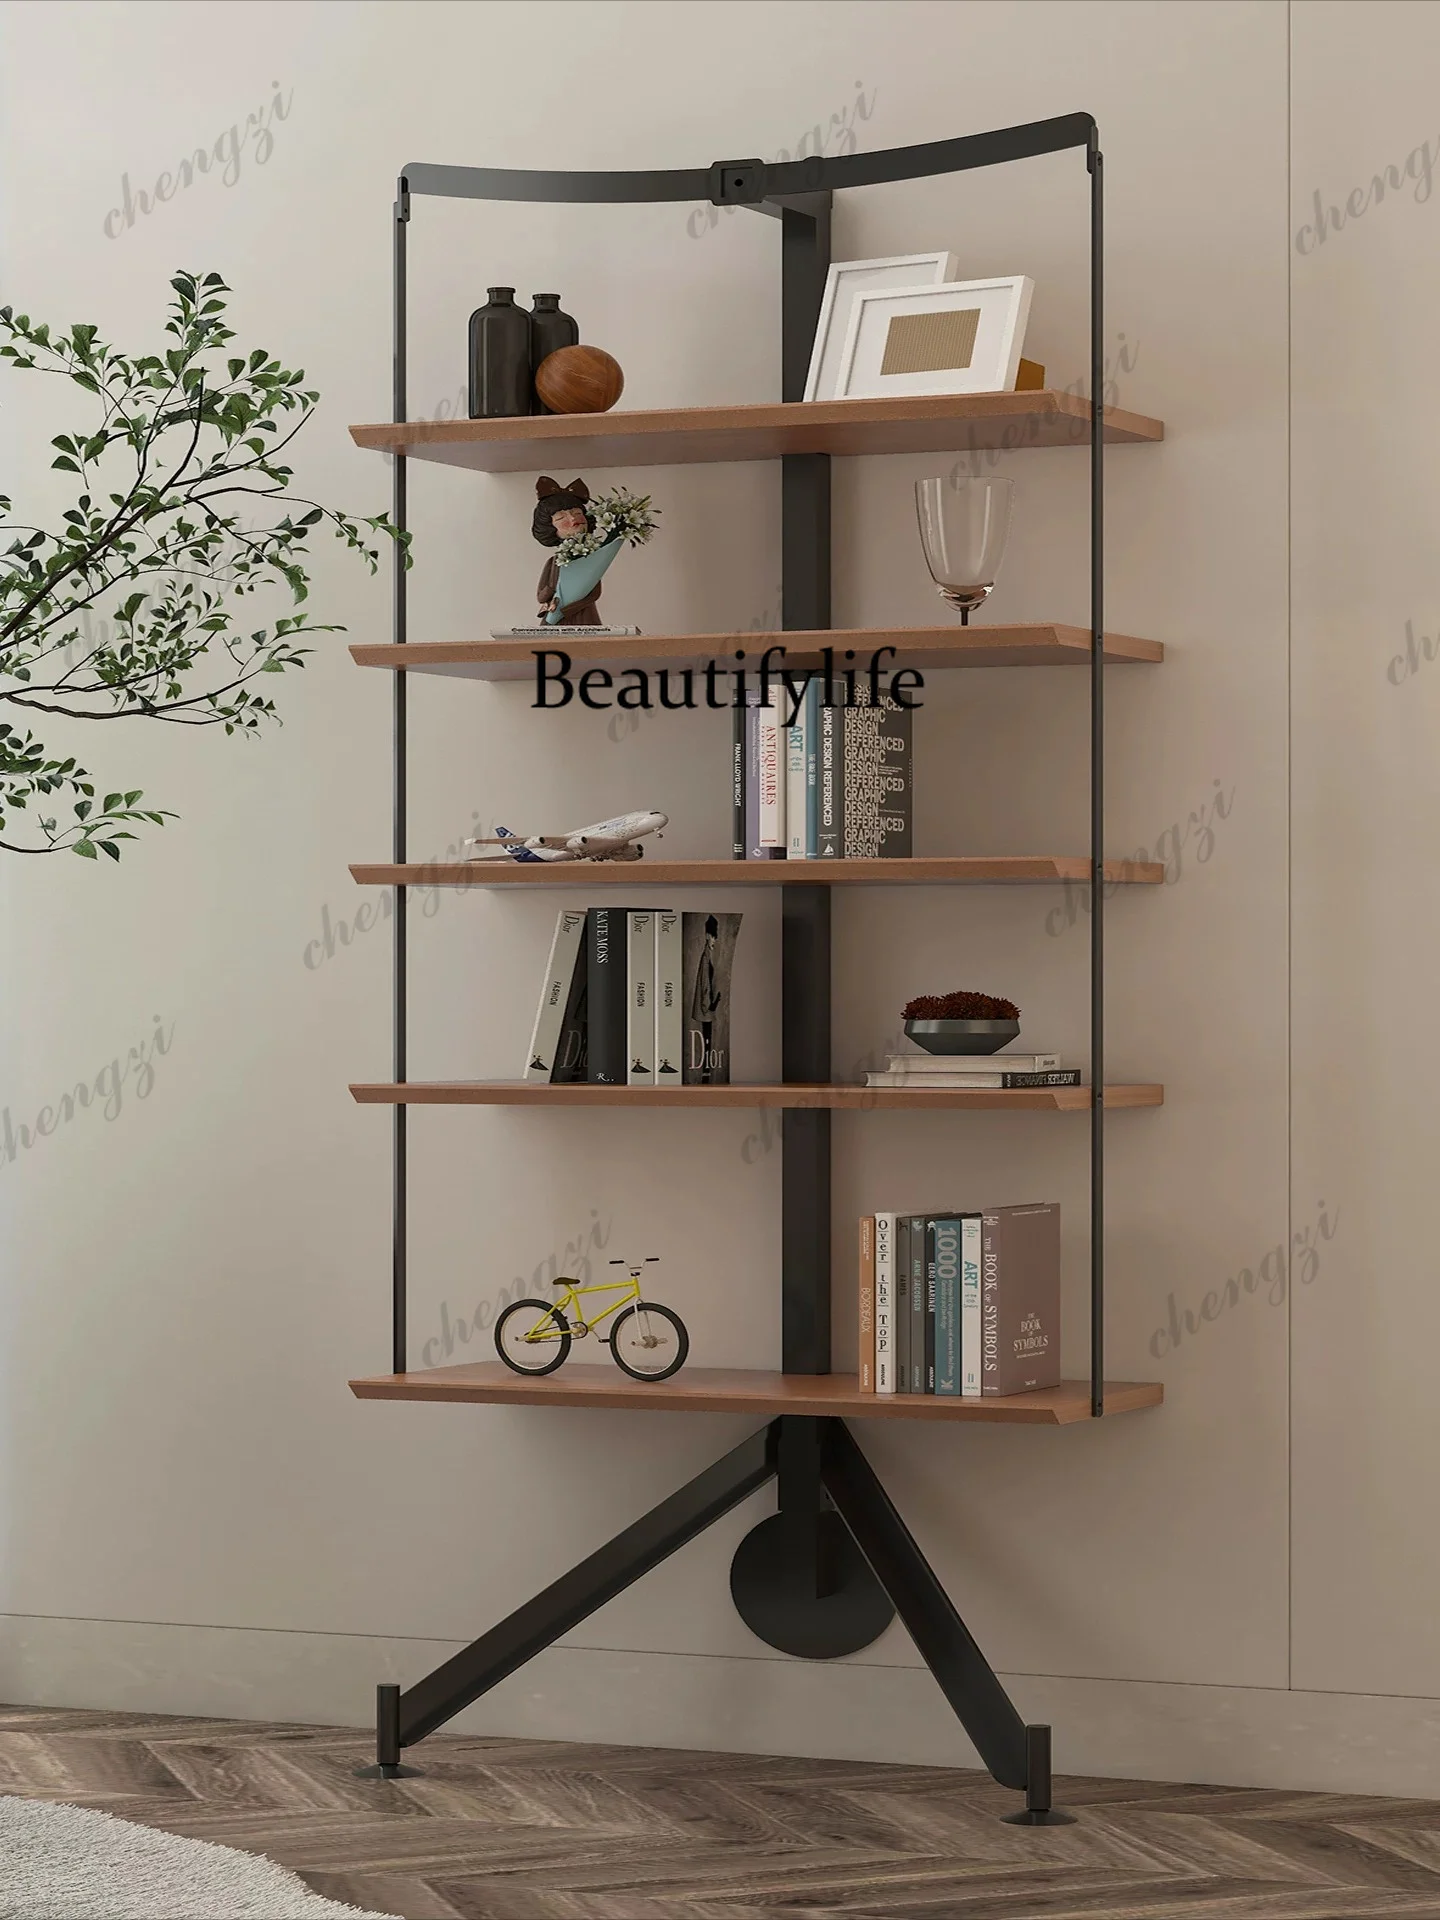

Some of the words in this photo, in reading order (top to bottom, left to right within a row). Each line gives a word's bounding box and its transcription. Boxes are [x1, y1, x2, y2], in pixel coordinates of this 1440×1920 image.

[844, 706, 886, 723] GRAPHIC
[844, 719, 879, 736] DESIGN
[844, 733, 905, 752] REFERENCED
[734, 743, 742, 762] FRANK
[823, 737, 832, 769] DESIGN
[844, 746, 886, 763] GRAPHIC
[734, 763, 742, 783] LLOYD
[765, 725, 776, 805] ANTIQUAIRES
[844, 760, 879, 776] DESIGN
[844, 773, 905, 792] REFERENCED
[734, 784, 742, 807] WRIGHT
[823, 770, 832, 826] REFERENCED
[844, 787, 886, 804] GRAPHIC
[844, 801, 879, 816] DESIGN
[844, 814, 905, 832] REFERENCED
[844, 828, 886, 844] GRAPHIC
[844, 841, 879, 857] DESIGN
[562, 915, 580, 934] Dior
[596, 910, 608, 937] KATE
[633, 915, 649, 933] Dior
[661, 915, 677, 933] Dior
[596, 938, 608, 964] MOSS
[549, 980, 562, 1006] FASHION
[636, 982, 646, 1007] FASHION
[664, 982, 673, 1007] FASHION
[688, 1029, 725, 1070] Dior
[878, 1219, 888, 1263] Over
[937, 1227, 958, 1279] 1000
[913, 1259, 922, 1277] ARNE
[928, 1262, 936, 1279] EERO
[964, 1260, 978, 1289] ART
[984, 1253, 998, 1292] BOOK
[928, 1280, 936, 1313] SAARINEN
[860, 1287, 871, 1333] BORDEAUX
[878, 1314, 888, 1352] Top
[1020, 1318, 1042, 1332] BOOK
[984, 1305, 998, 1371] SYMBOLS
[1013, 1334, 1049, 1352] SYMBOLS
